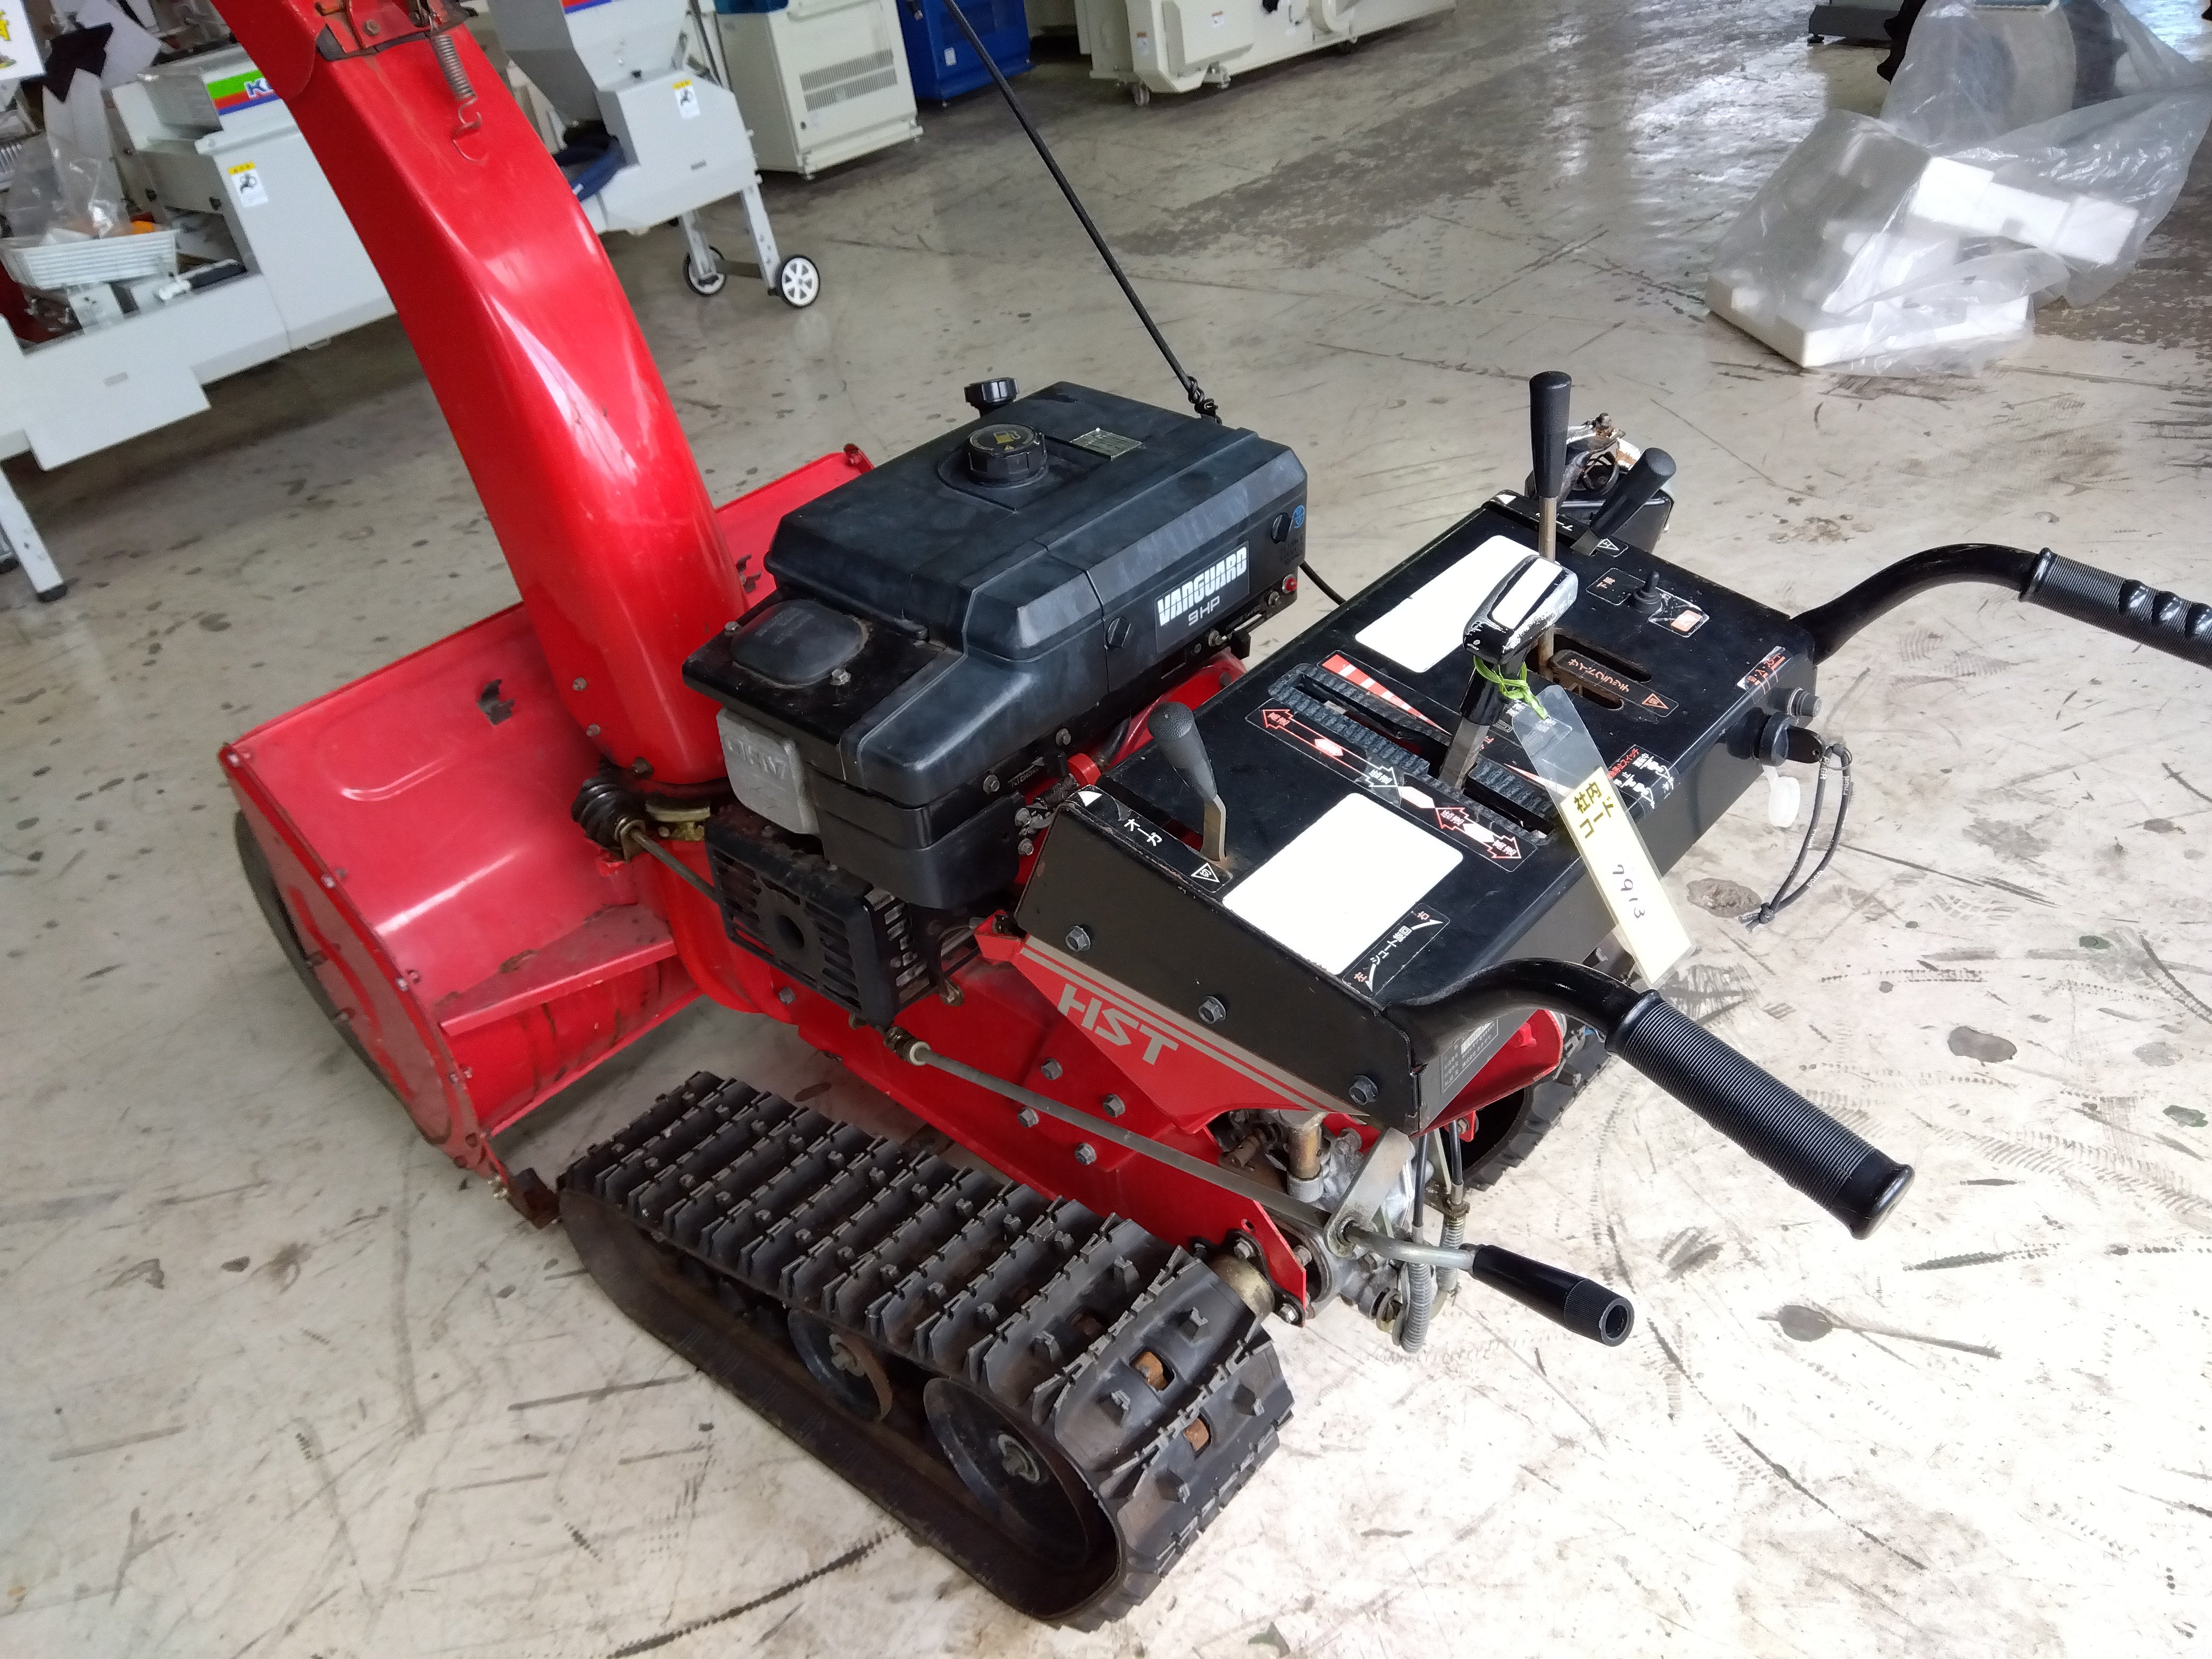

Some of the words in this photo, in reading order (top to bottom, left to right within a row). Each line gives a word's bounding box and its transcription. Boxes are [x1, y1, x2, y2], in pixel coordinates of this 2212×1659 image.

[1158, 547, 1247, 626] VANGUARD
[1569, 658, 1630, 692] サイドクラッチ
[1573, 781, 1603, 814] 社内
[1124, 818, 1163, 846] オーガ
[1440, 809, 1465, 826] 低速
[1580, 797, 1614, 839] コード
[1493, 839, 1516, 857] 高速
[1200, 868, 1213, 878] 切
[1612, 864, 1646, 919] 7913
[1417, 910, 1430, 921] 右
[1370, 925, 1413, 966] シュート旋回
[1353, 971, 1367, 983] 左
[1058, 983, 1179, 1066] HST
